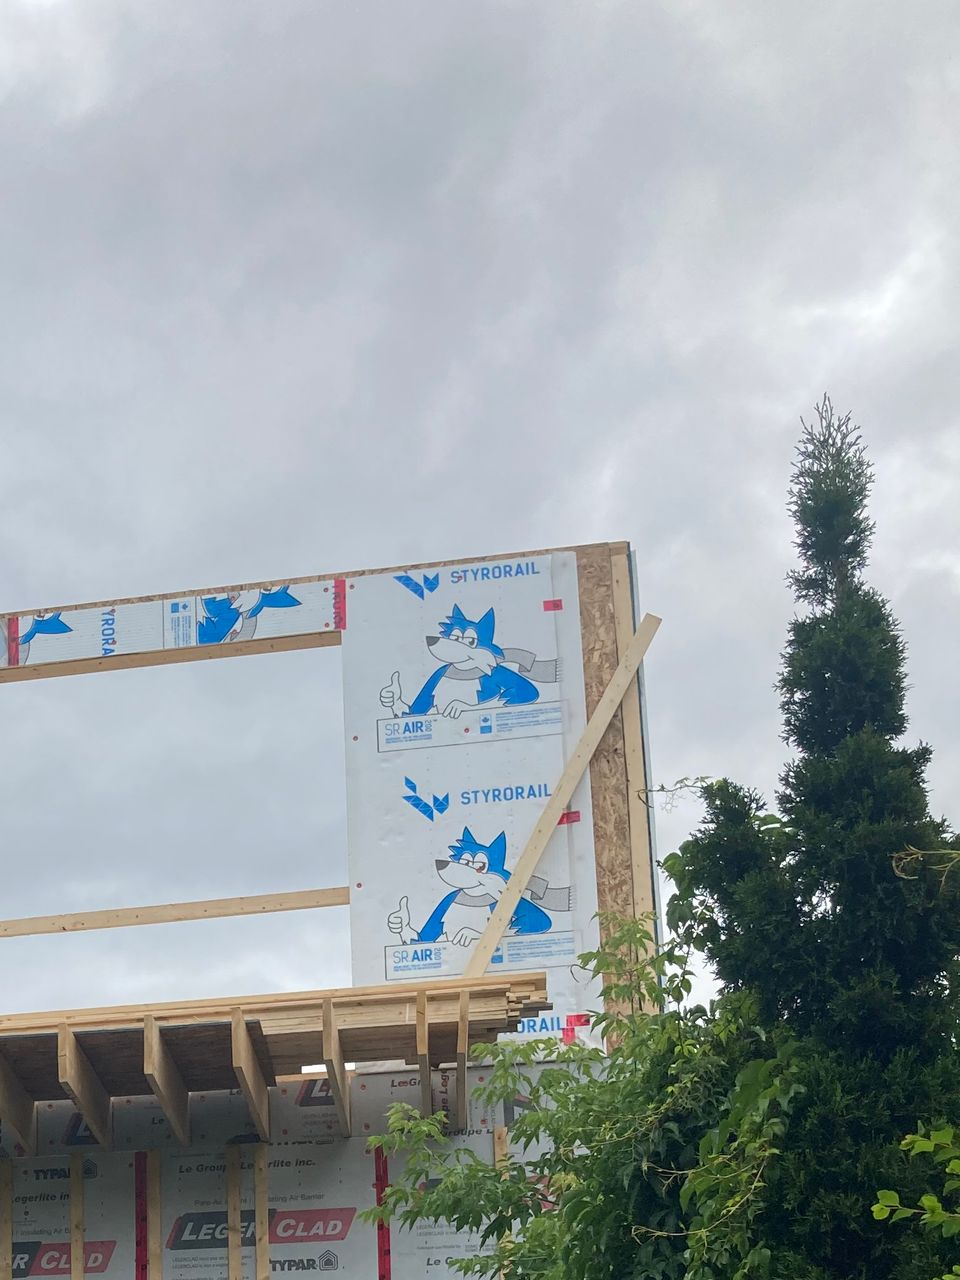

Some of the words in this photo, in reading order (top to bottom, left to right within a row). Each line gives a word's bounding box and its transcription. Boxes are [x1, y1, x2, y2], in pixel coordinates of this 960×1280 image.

[451, 562, 540, 584] STYRORAIL
[384, 723, 401, 736] SR
[403, 720, 424, 734] AIR
[460, 783, 552, 805] STYRORAIL
[393, 951, 409, 964] SR
[411, 948, 433, 962] AIR
[33, 1167, 71, 1181] TYPA
[196, 1163, 227, 1174] Group
[241, 1158, 291, 1170] Lerlite
[12, 1193, 57, 1205] egerlite
[276, 1218, 343, 1238] CLAD
[41, 1250, 104, 1271] CLD
[269, 1258, 318, 1272] TYPAR
